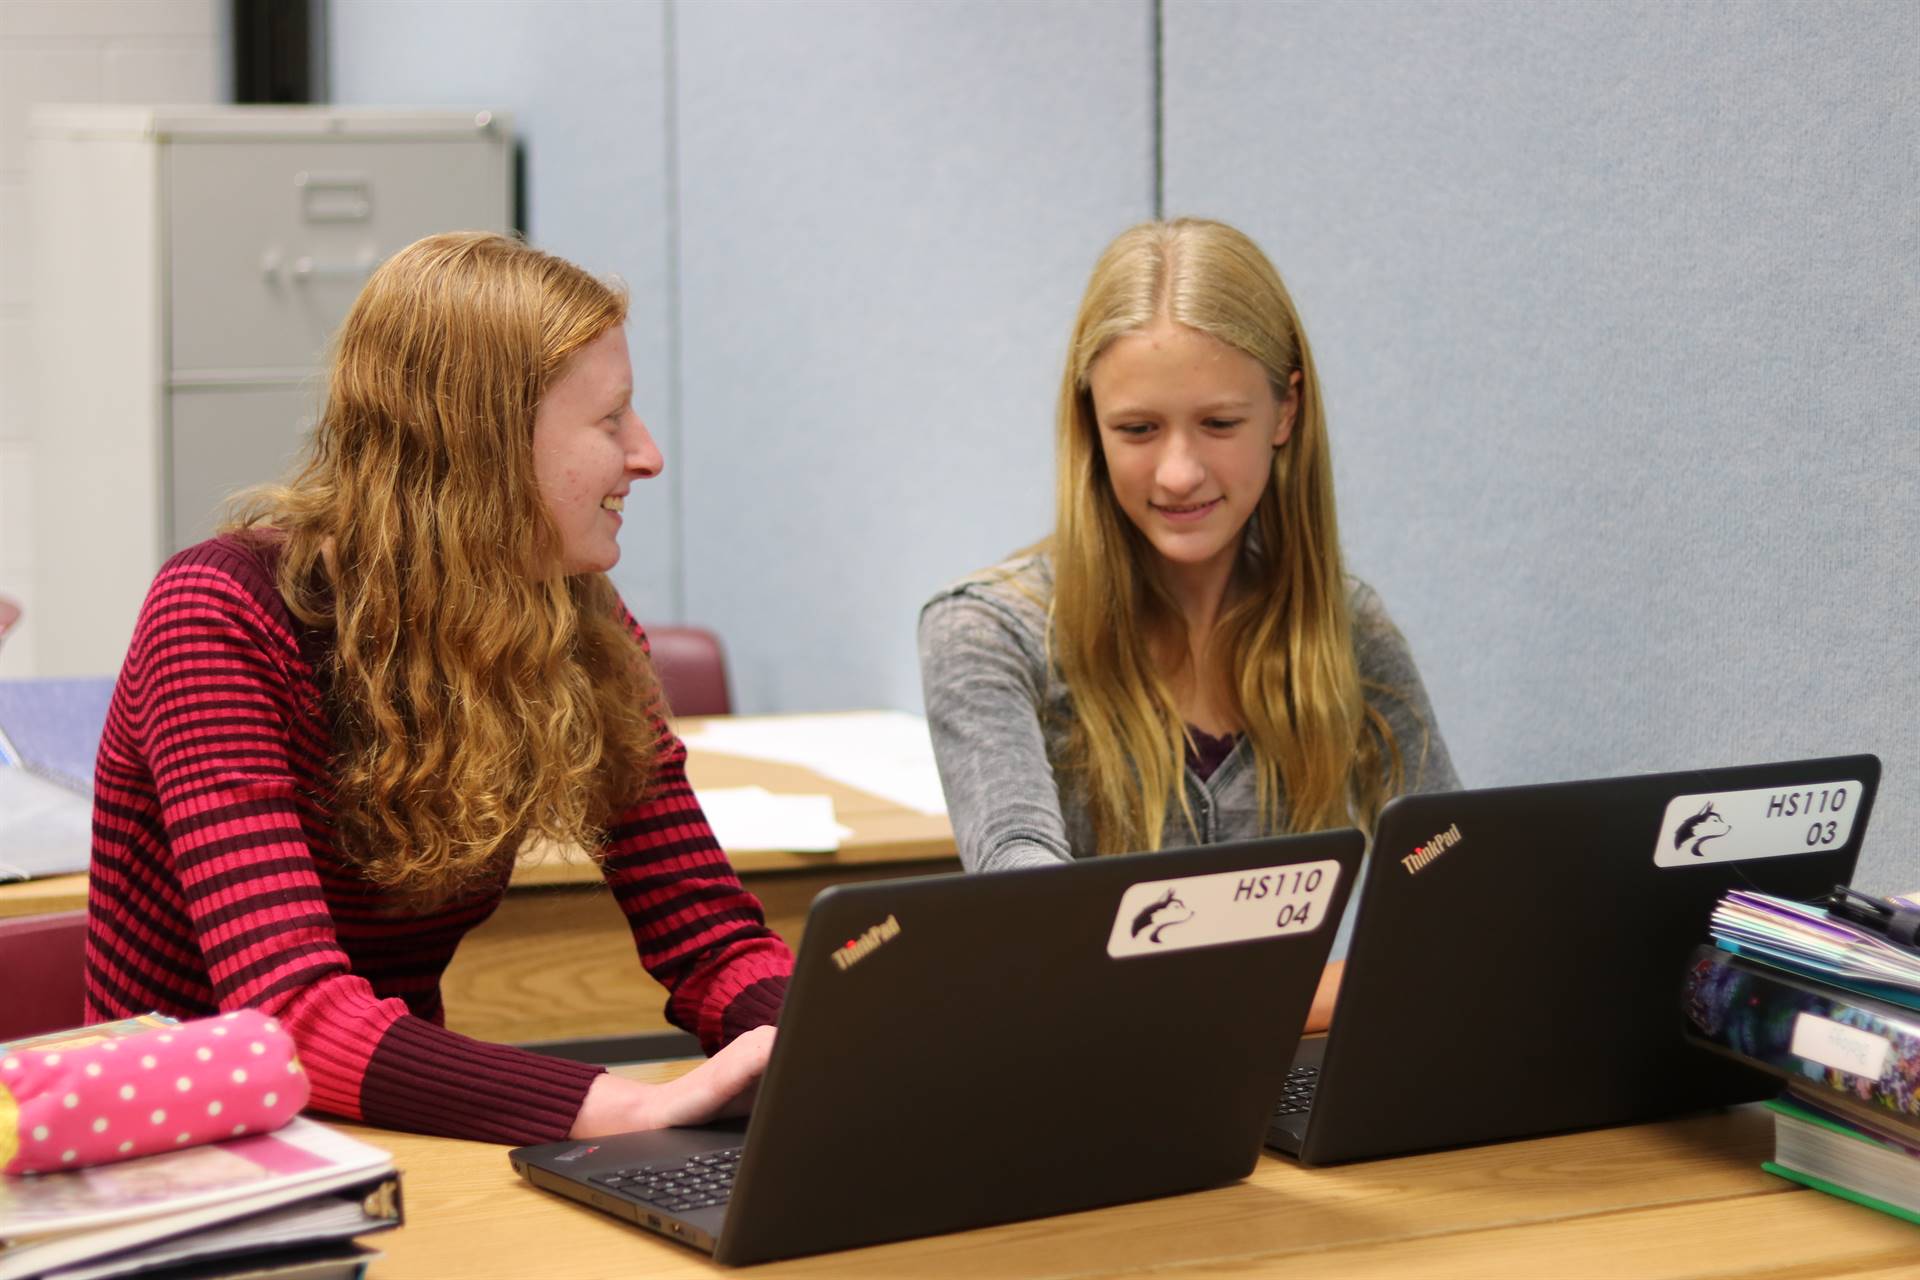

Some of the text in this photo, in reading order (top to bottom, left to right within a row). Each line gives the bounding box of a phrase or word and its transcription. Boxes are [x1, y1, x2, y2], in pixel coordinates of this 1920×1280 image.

[1766, 788, 1847, 818] HS110
[1401, 823, 1462, 874] ThinkPad
[1806, 820, 1837, 846] 03
[1234, 869, 1322, 902] HS110
[1277, 901, 1311, 928] 04
[831, 913, 901, 970] ThinkPad
